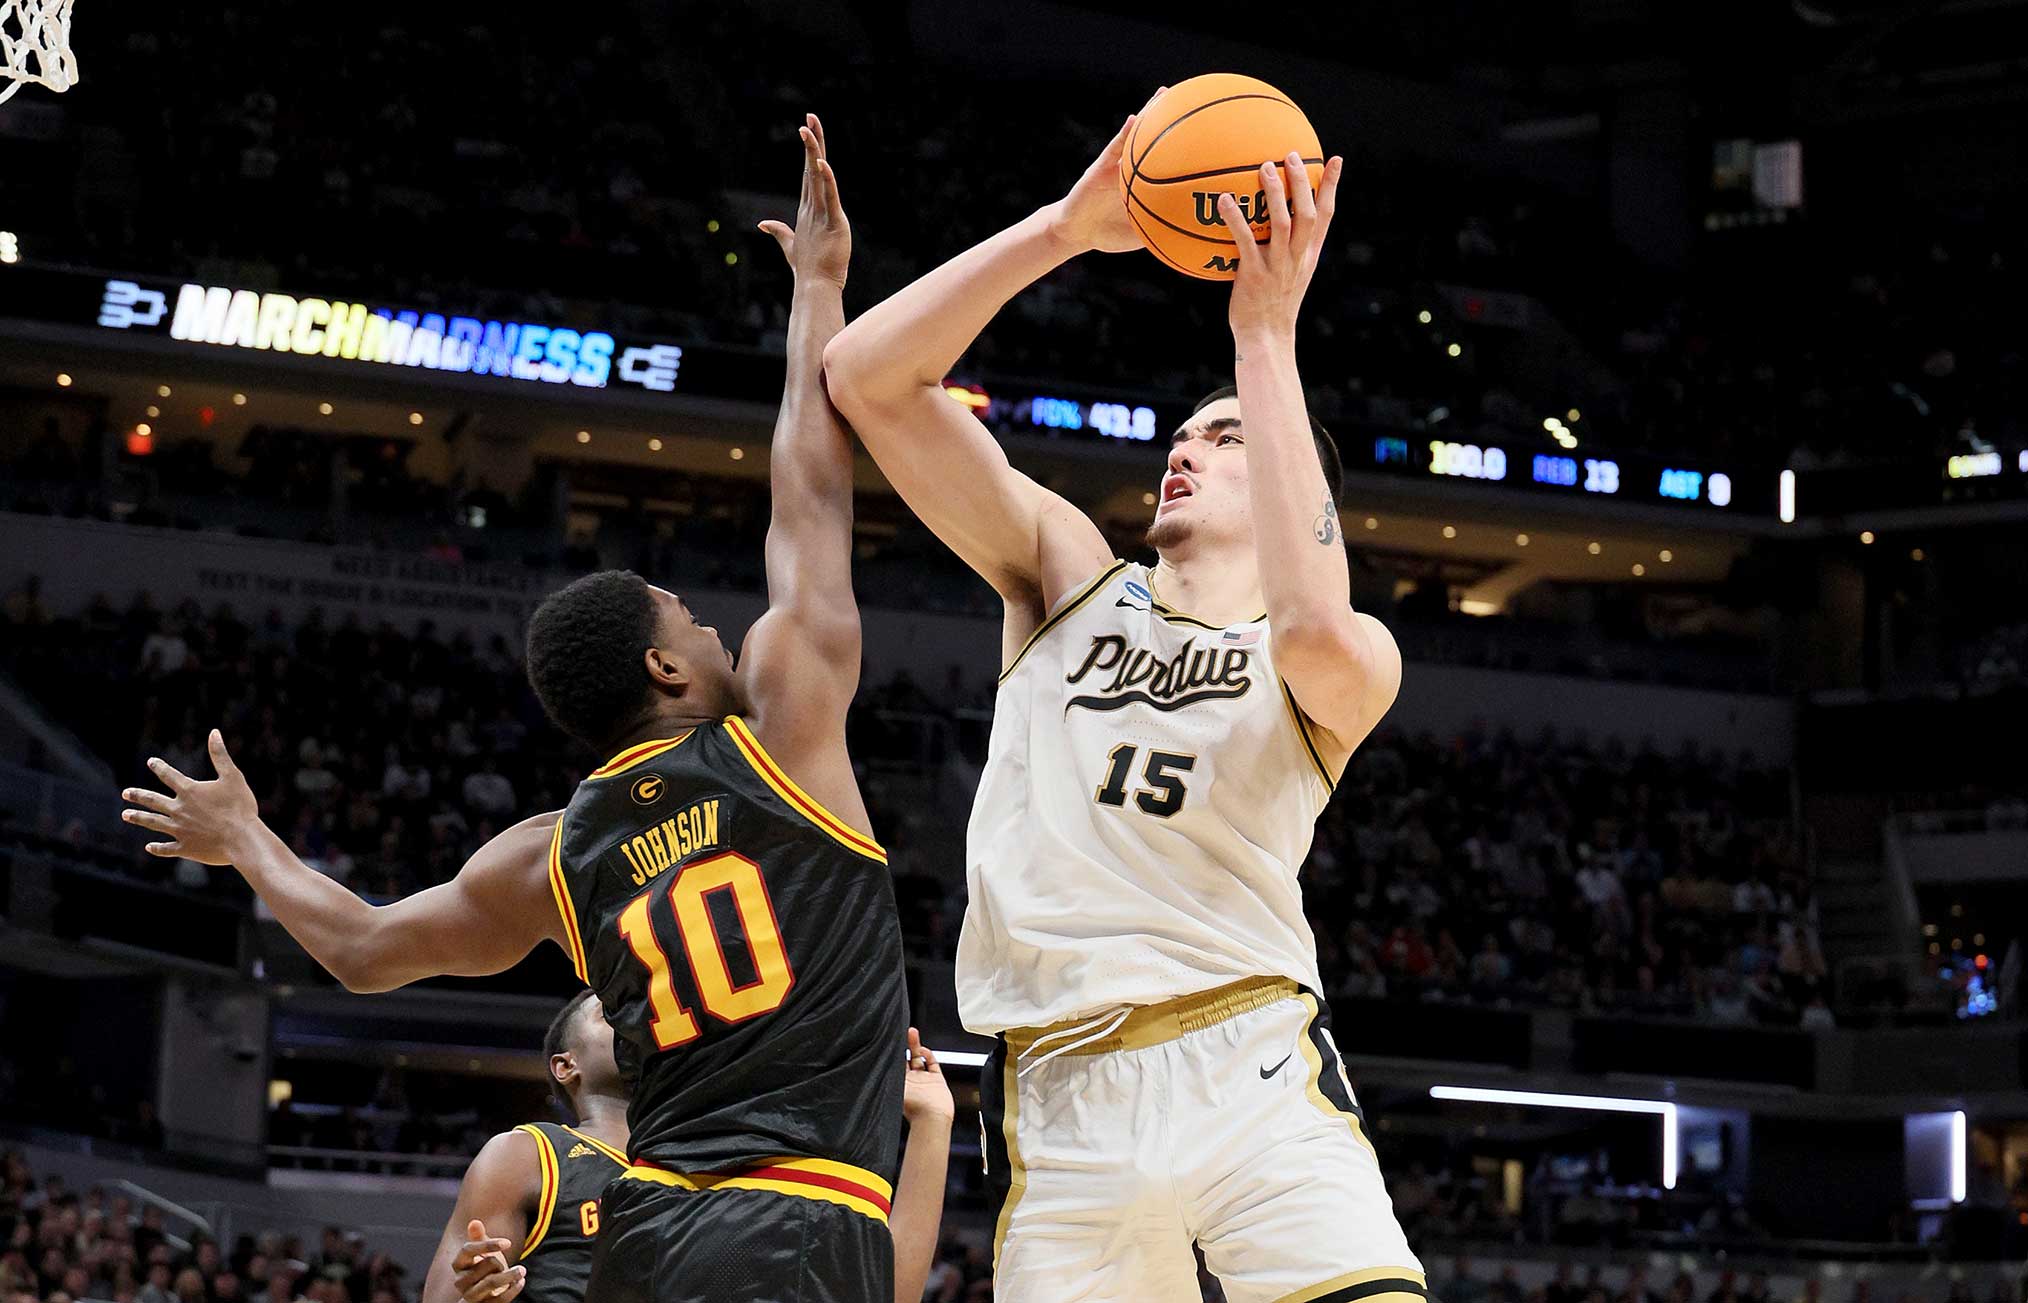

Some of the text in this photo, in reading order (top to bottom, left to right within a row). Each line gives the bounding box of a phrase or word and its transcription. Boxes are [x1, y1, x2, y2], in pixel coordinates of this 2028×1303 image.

[1067, 634, 1251, 705] Purdue
[1094, 741, 1199, 819] 15
[620, 799, 720, 887] JOHNSON
[616, 850, 796, 1051] 10
